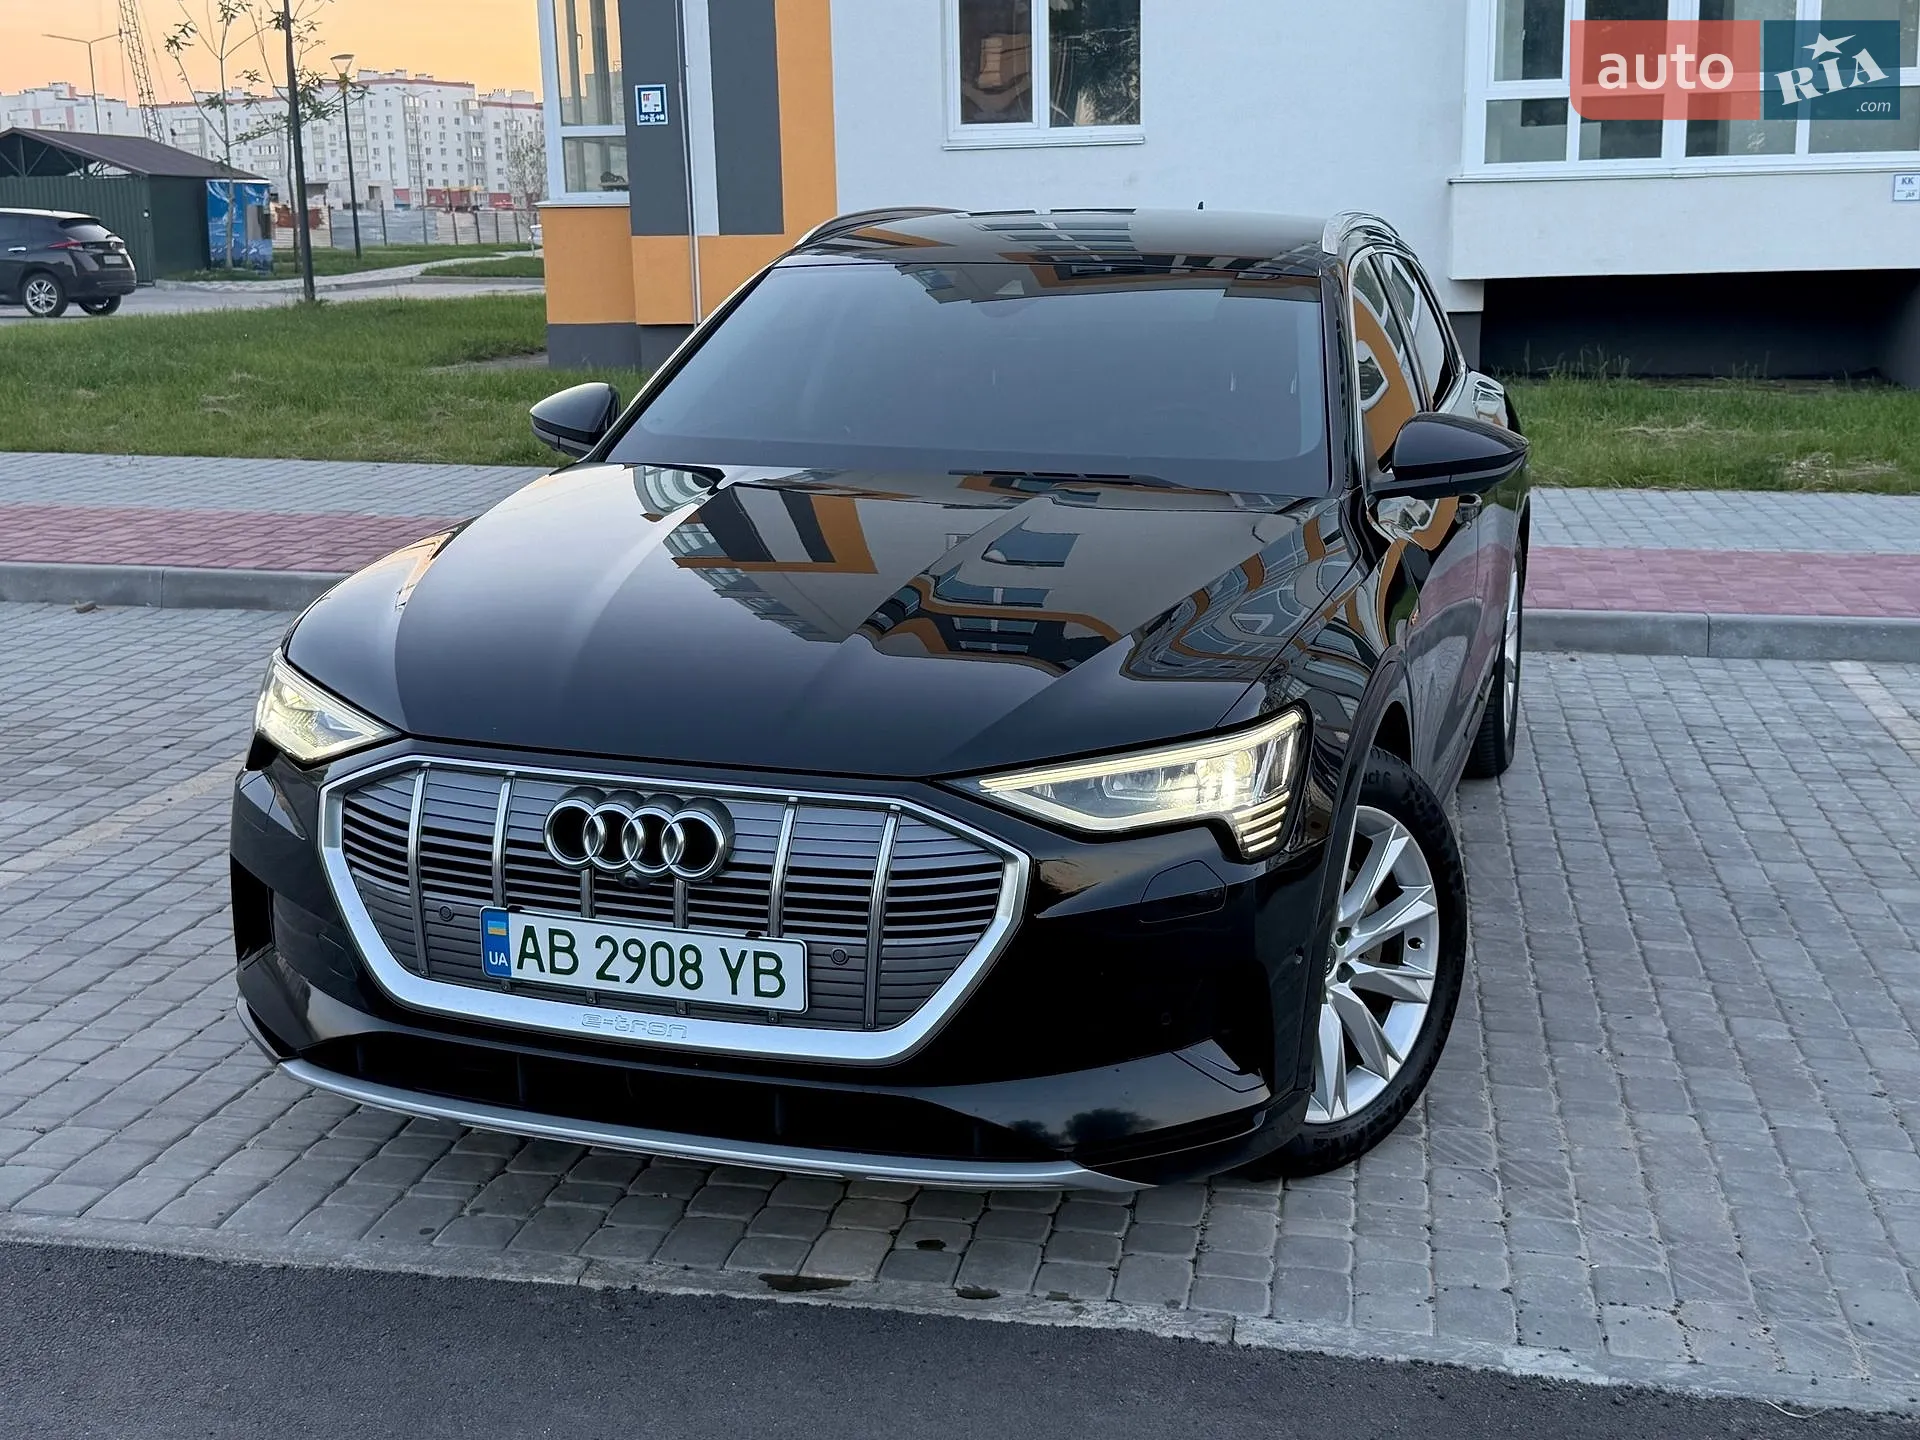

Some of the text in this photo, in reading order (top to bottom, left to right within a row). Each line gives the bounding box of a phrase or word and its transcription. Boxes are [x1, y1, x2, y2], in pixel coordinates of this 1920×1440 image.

[489, 950, 509, 967] UA
[517, 925, 786, 998] AB 2908 YB
[581, 1013, 688, 1039] e-tron
